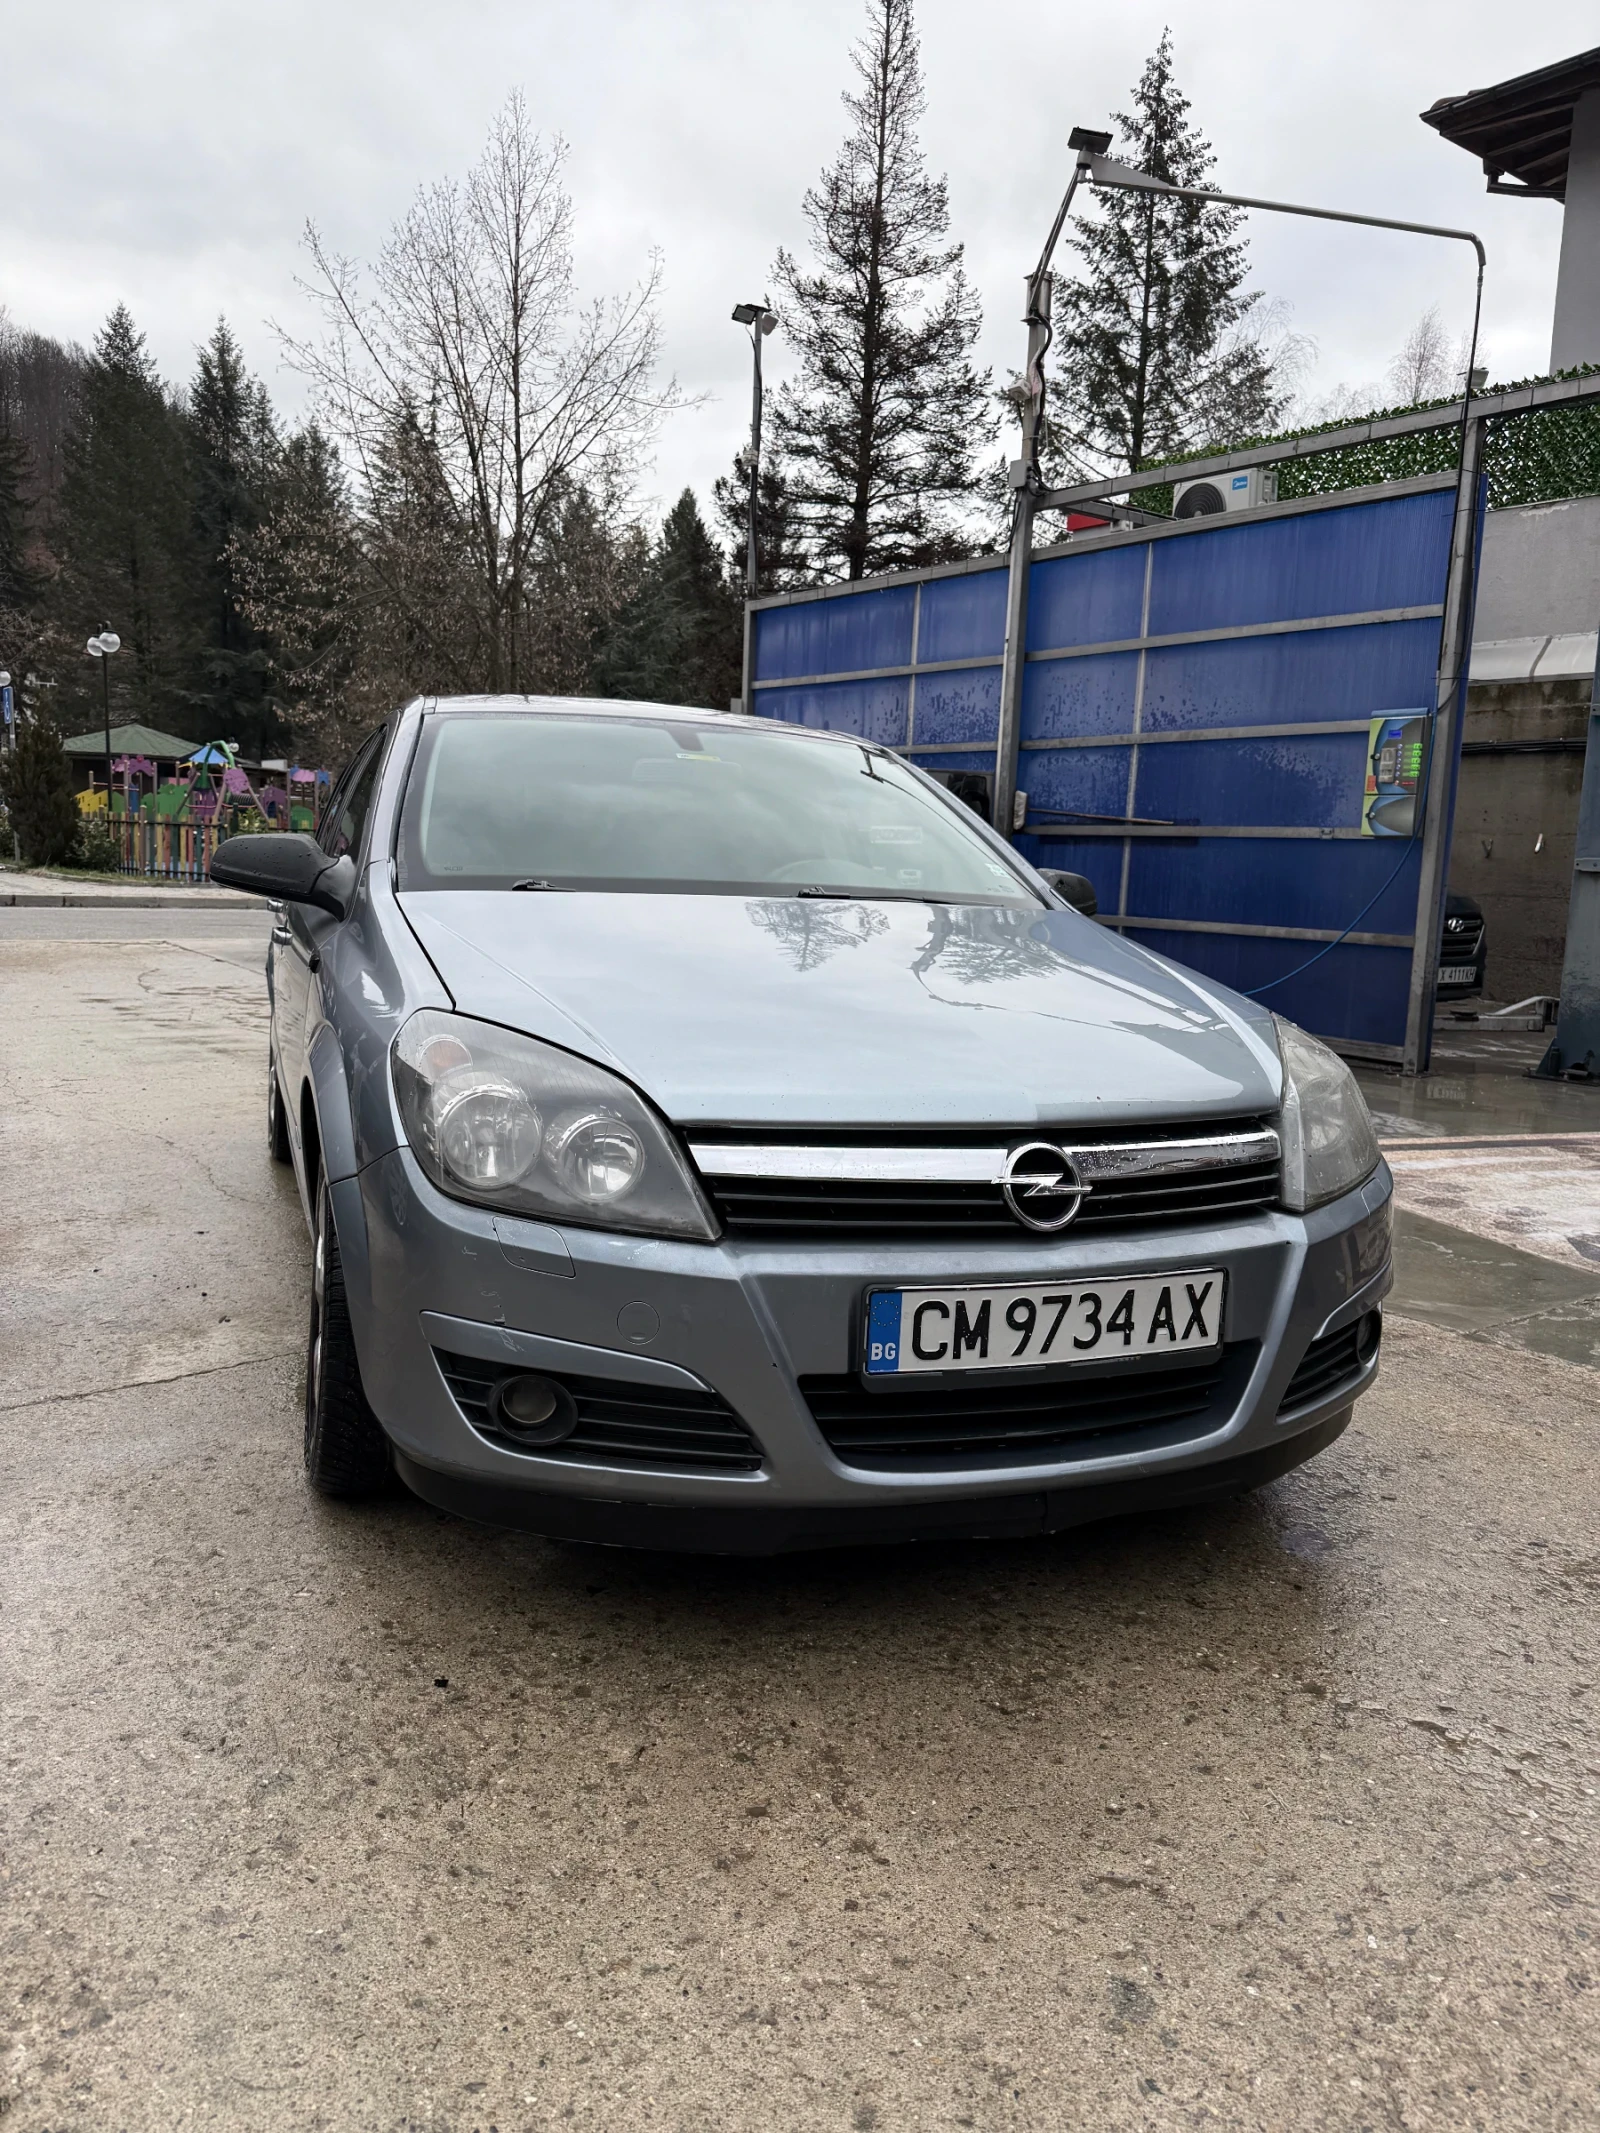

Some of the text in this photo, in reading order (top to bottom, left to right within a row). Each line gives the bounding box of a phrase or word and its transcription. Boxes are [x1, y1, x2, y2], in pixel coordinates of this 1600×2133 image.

[911, 1281, 1214, 1361] CM 9734 AX
[870, 1342, 897, 1361] BG
